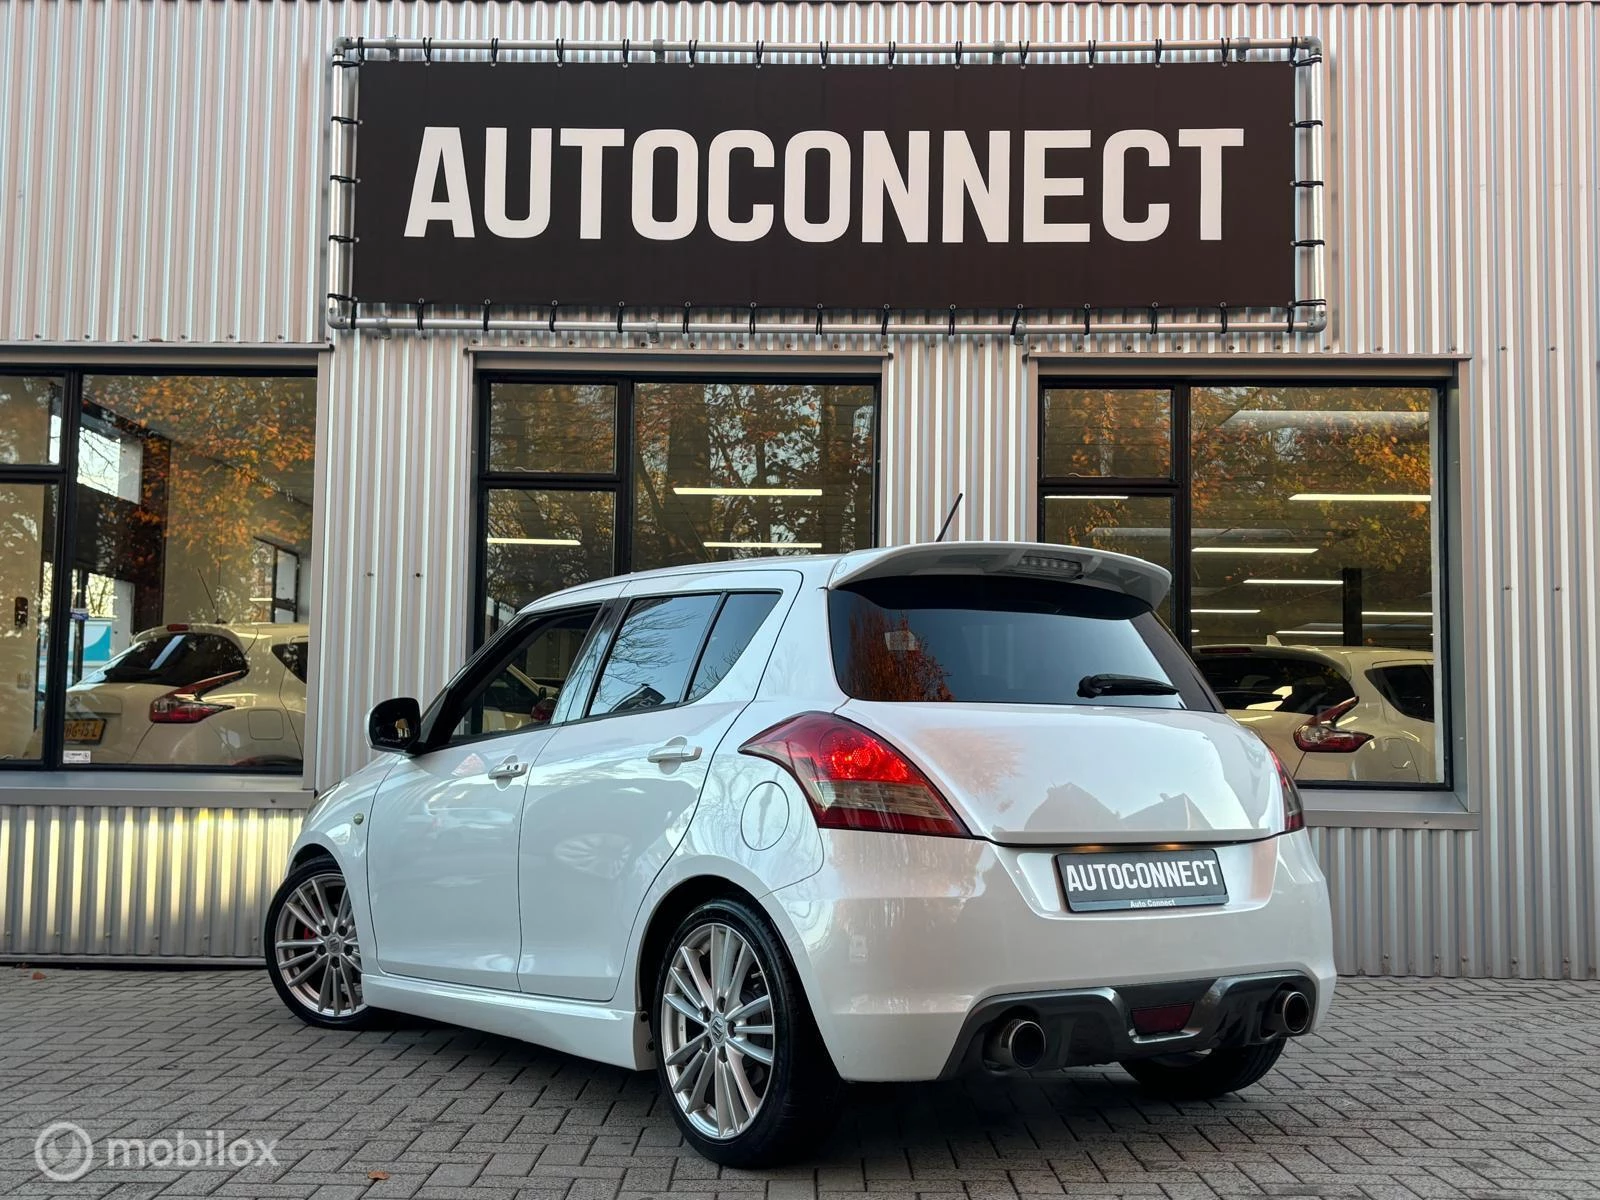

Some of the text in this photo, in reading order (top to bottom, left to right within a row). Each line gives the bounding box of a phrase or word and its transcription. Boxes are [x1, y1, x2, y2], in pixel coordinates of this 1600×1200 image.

[403, 126, 1245, 244] AUTOCONNECT
[1065, 859, 1219, 892] AUTOCONNECT
[1130, 899, 1176, 909] Auto Connect
